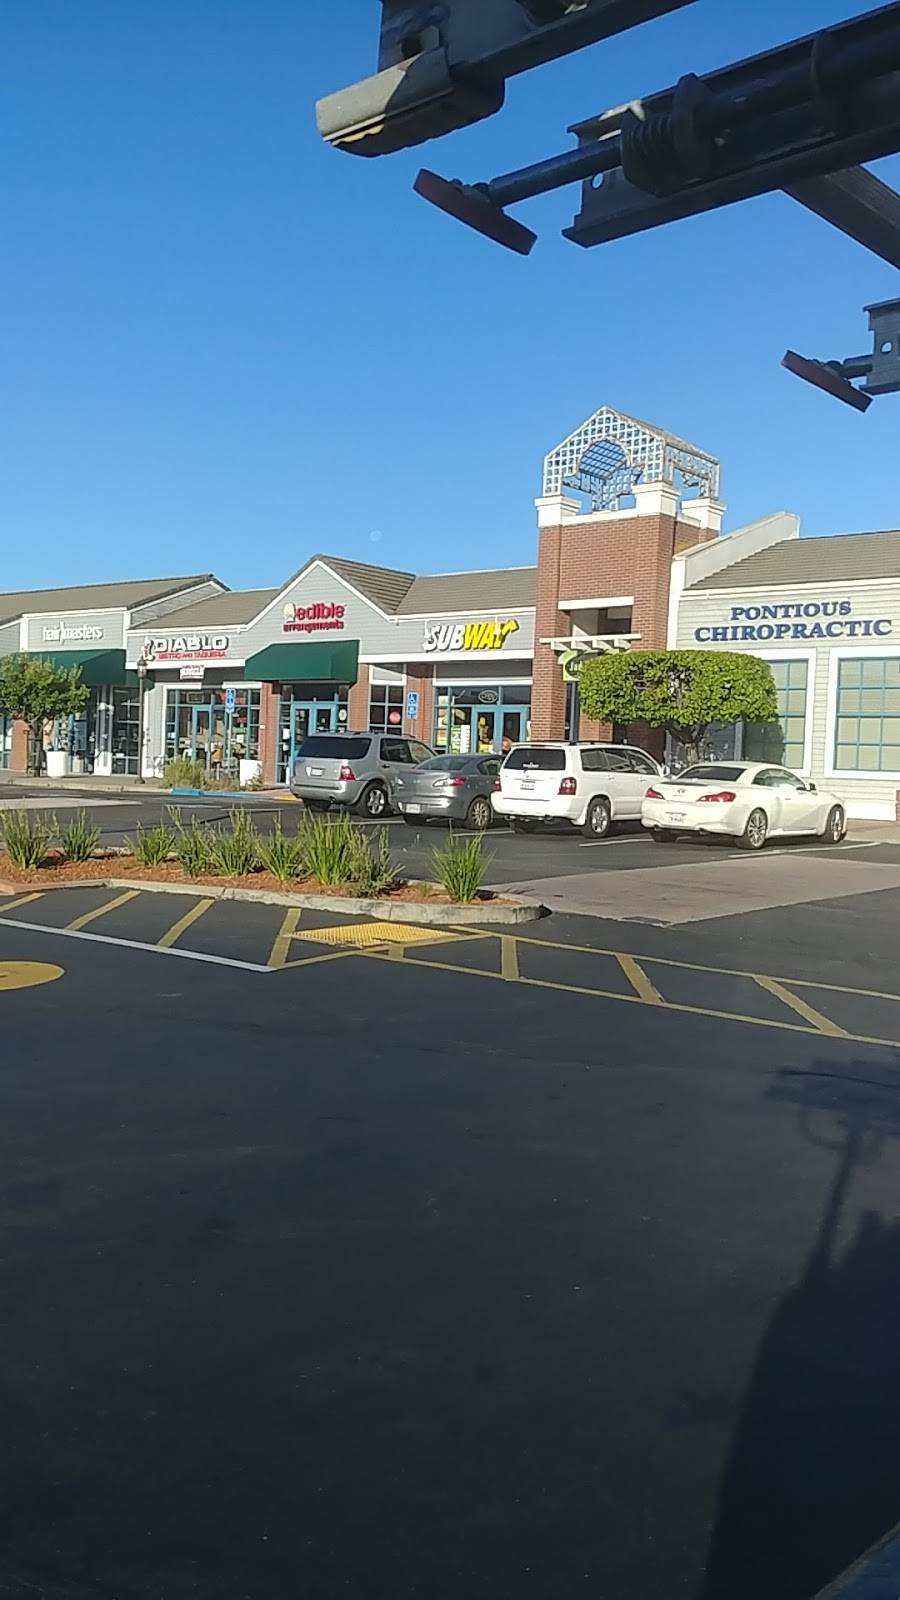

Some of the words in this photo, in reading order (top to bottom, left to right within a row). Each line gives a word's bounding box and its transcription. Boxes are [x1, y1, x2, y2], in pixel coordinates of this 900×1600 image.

[297, 603, 344, 620] edible
[731, 602, 852, 620] PONTIOUS
[283, 621, 344, 633] arrangements
[694, 620, 893, 642] CHIROPRACTIC
[155, 636, 228, 652] DIABLO
[422, 620, 519, 652] SUBWAY
